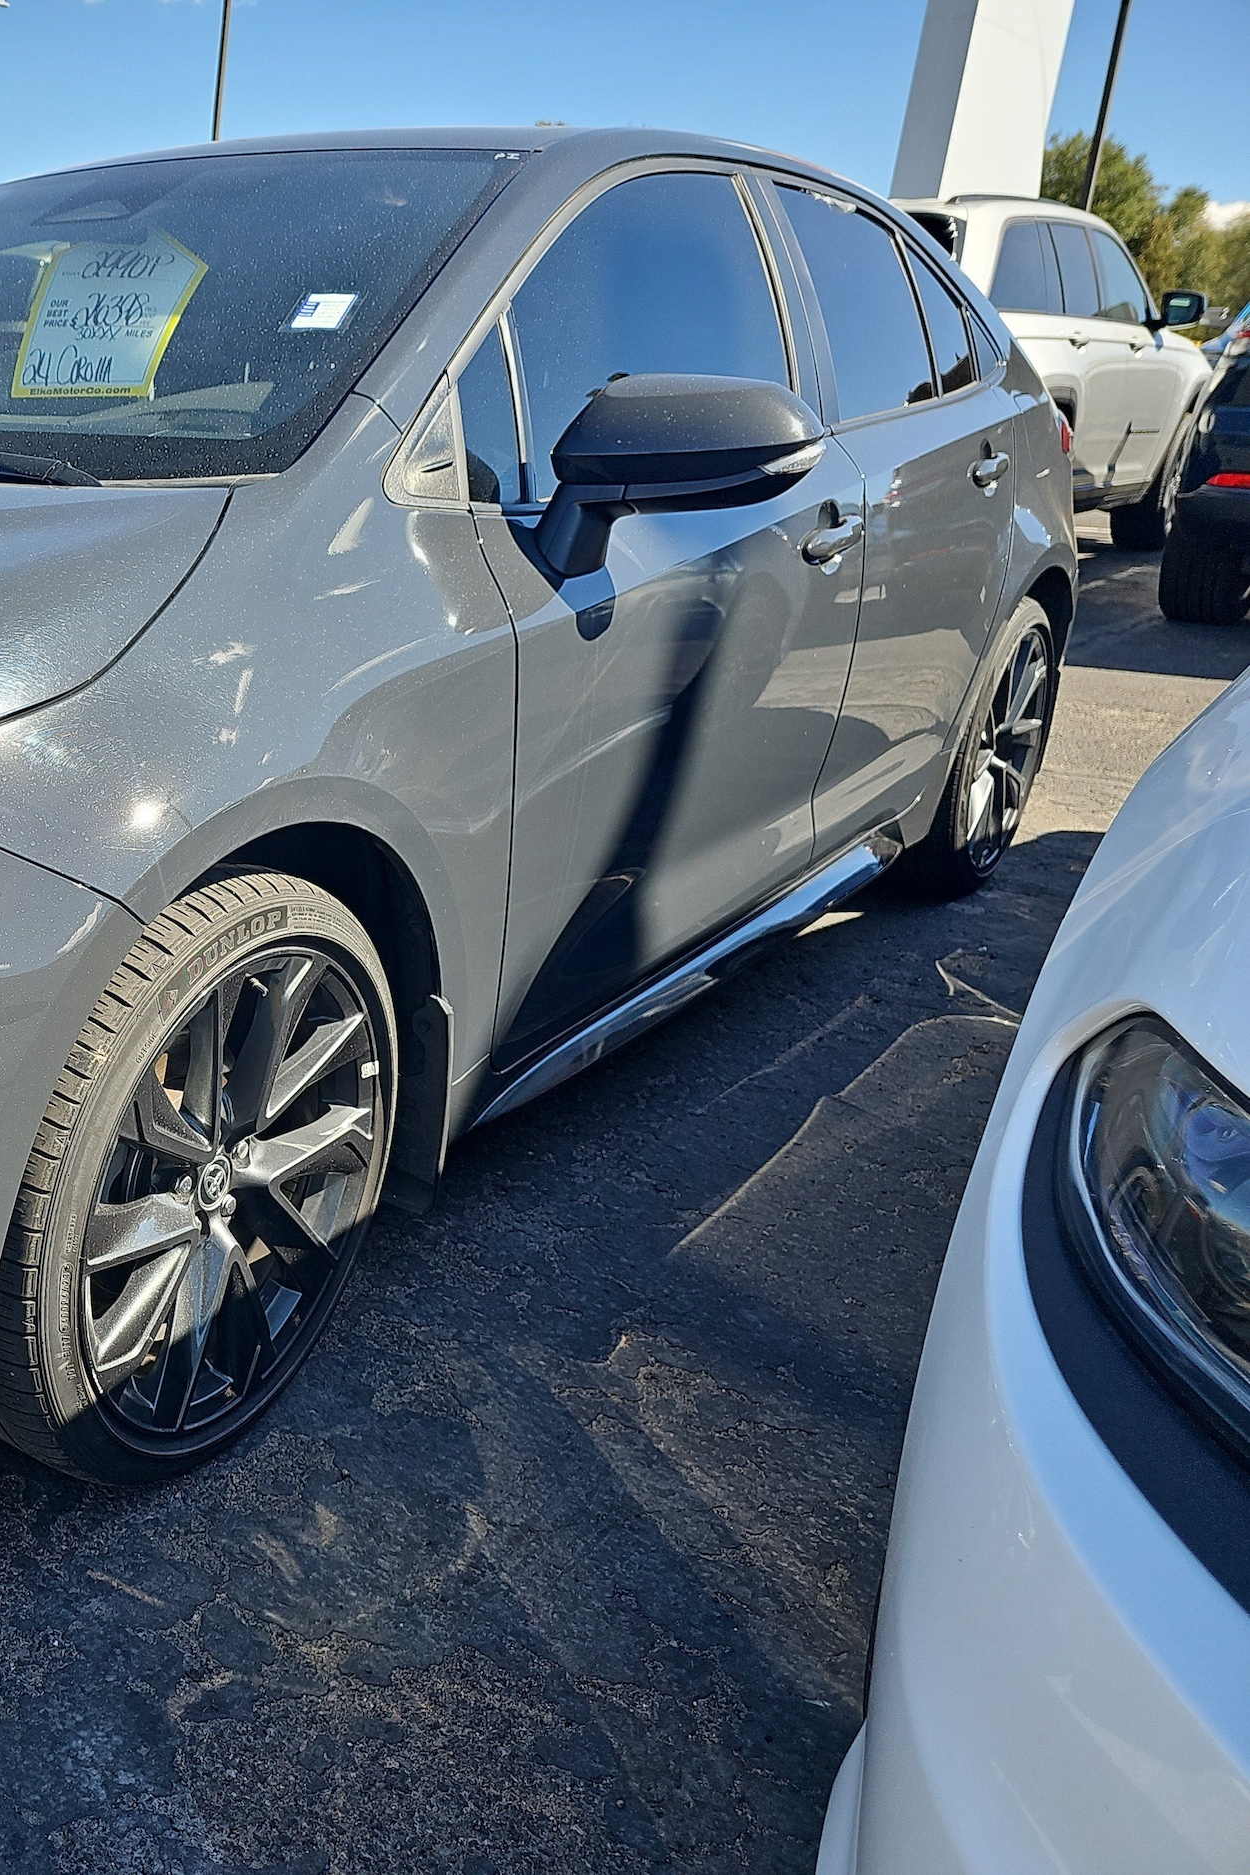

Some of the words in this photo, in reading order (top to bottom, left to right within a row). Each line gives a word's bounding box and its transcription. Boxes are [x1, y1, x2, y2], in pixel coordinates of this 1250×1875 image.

[50, 299, 69, 307] OUR
[46, 309, 68, 318] BEST
[43, 319, 68, 328] PRICE
[124, 329, 152, 338] MILES
[22, 348, 52, 386] 24
[30, 386, 131, 396] ElkoMotorCo.com
[186, 908, 284, 987] DUNLOP
[135, 1031, 159, 1065] OUTSIDE
